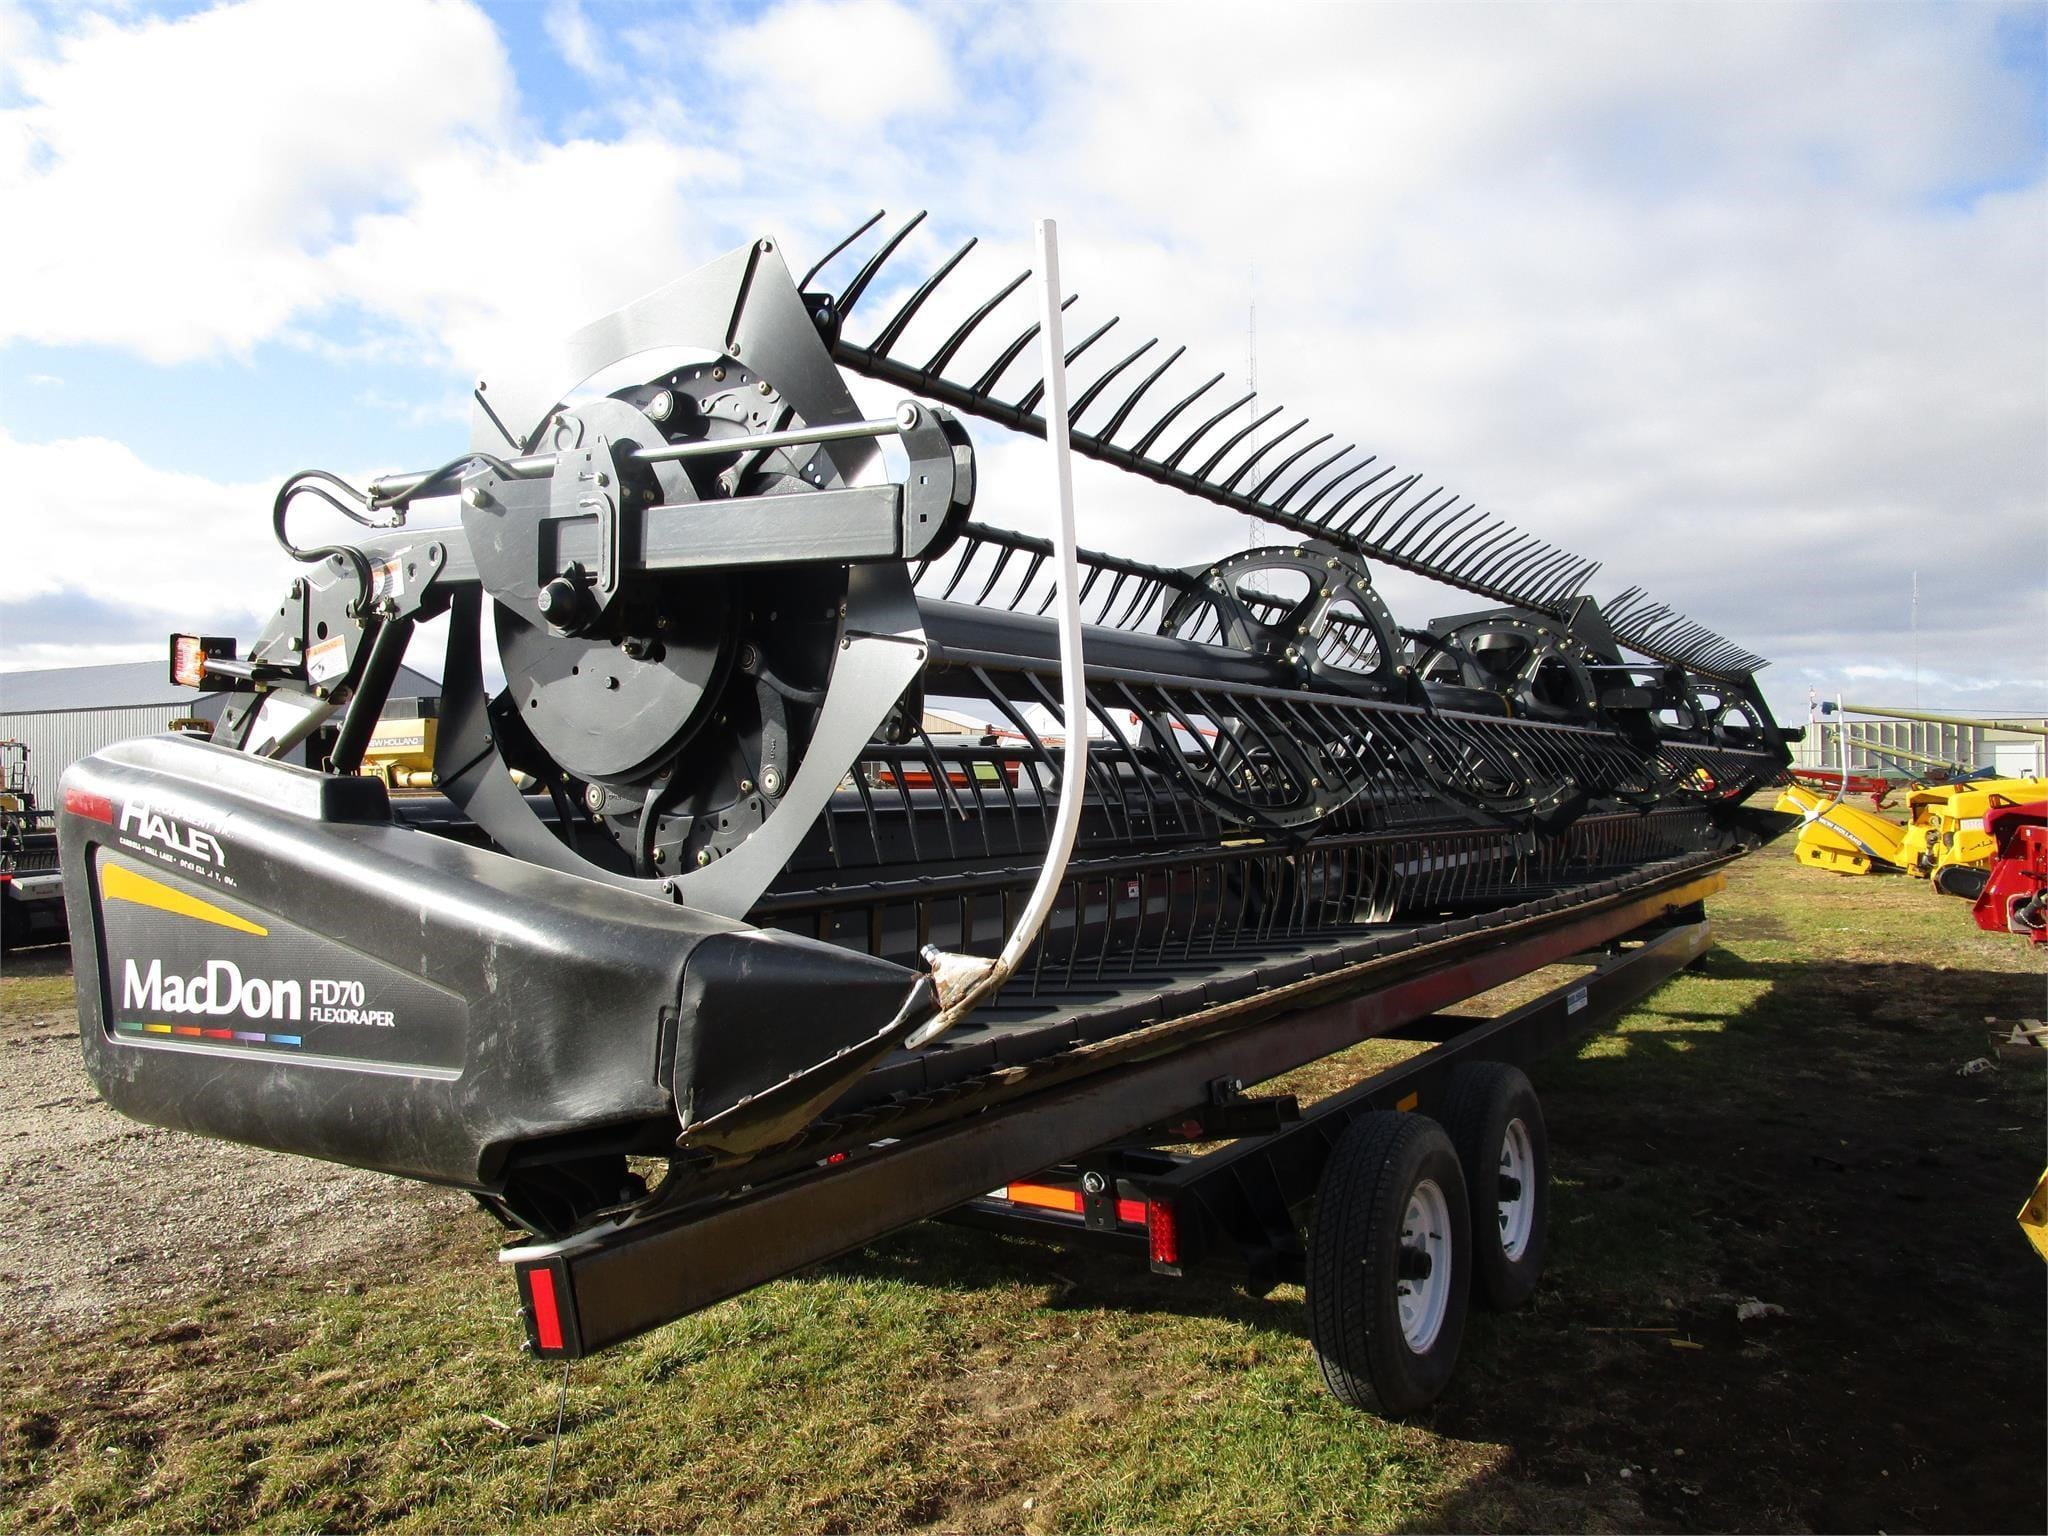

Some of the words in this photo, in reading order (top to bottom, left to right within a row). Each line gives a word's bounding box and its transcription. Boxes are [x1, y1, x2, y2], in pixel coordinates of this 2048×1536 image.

[369, 739, 384, 748] EW
[384, 737, 418, 747] HOLLAND
[119, 798, 226, 868] HALEY
[1818, 816, 1834, 828] NEW
[1833, 824, 1863, 847] HOLLAND
[122, 958, 302, 1021] MacDon
[309, 979, 366, 1008] FD70
[309, 1008, 396, 1028] FLEXDRAPER
